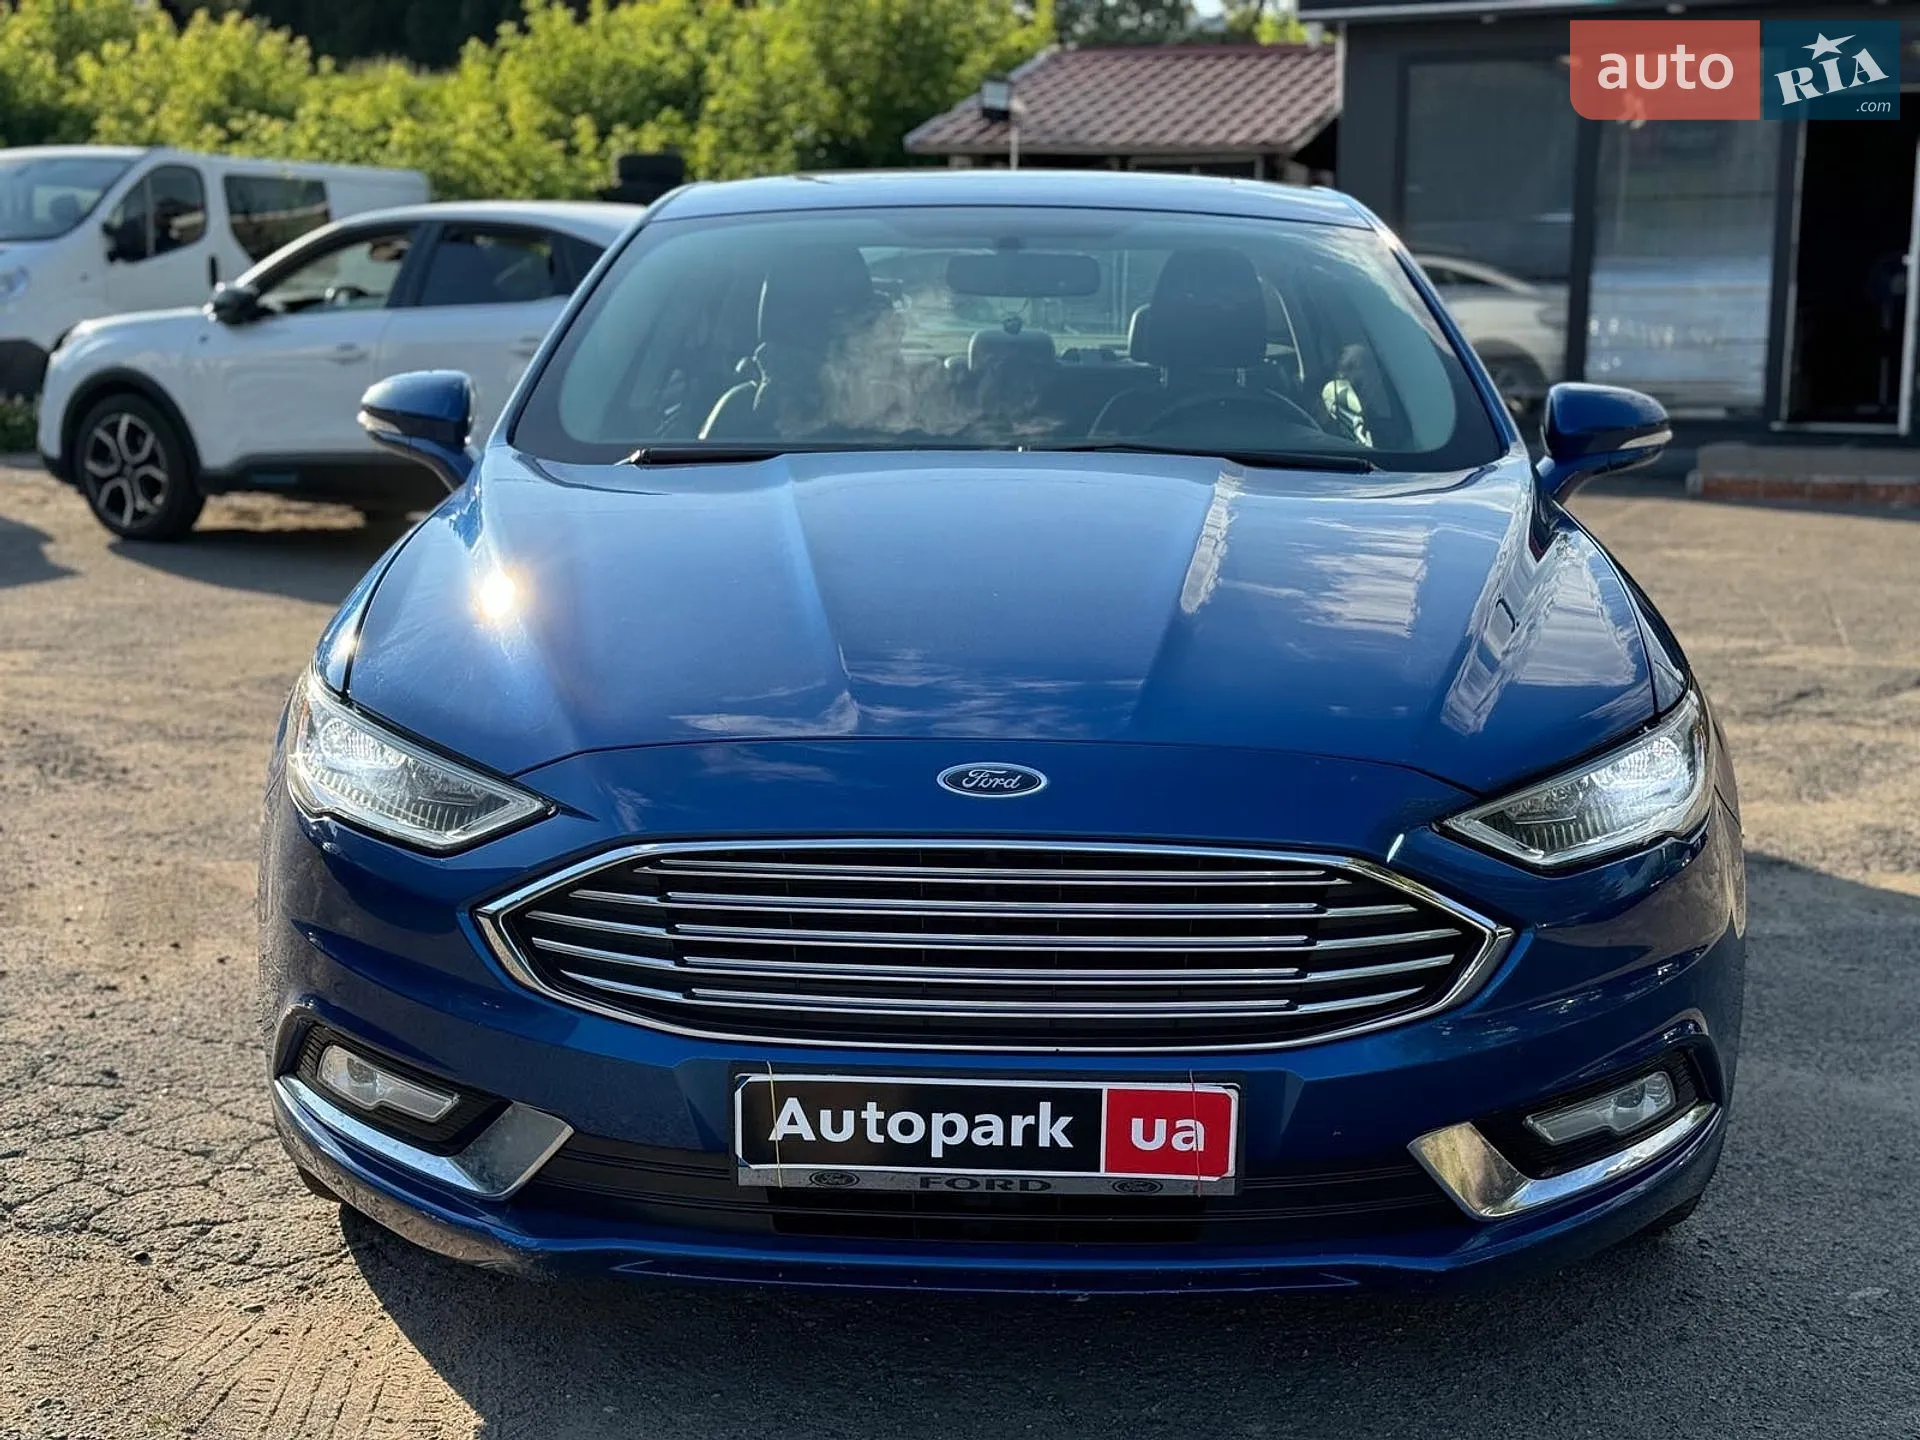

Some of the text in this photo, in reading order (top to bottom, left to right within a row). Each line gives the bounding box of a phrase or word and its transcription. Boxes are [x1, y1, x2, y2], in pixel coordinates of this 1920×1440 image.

[962, 769, 1022, 789] Ford
[768, 1097, 1205, 1158] Autopark ua
[919, 1175, 1052, 1192] FORD
